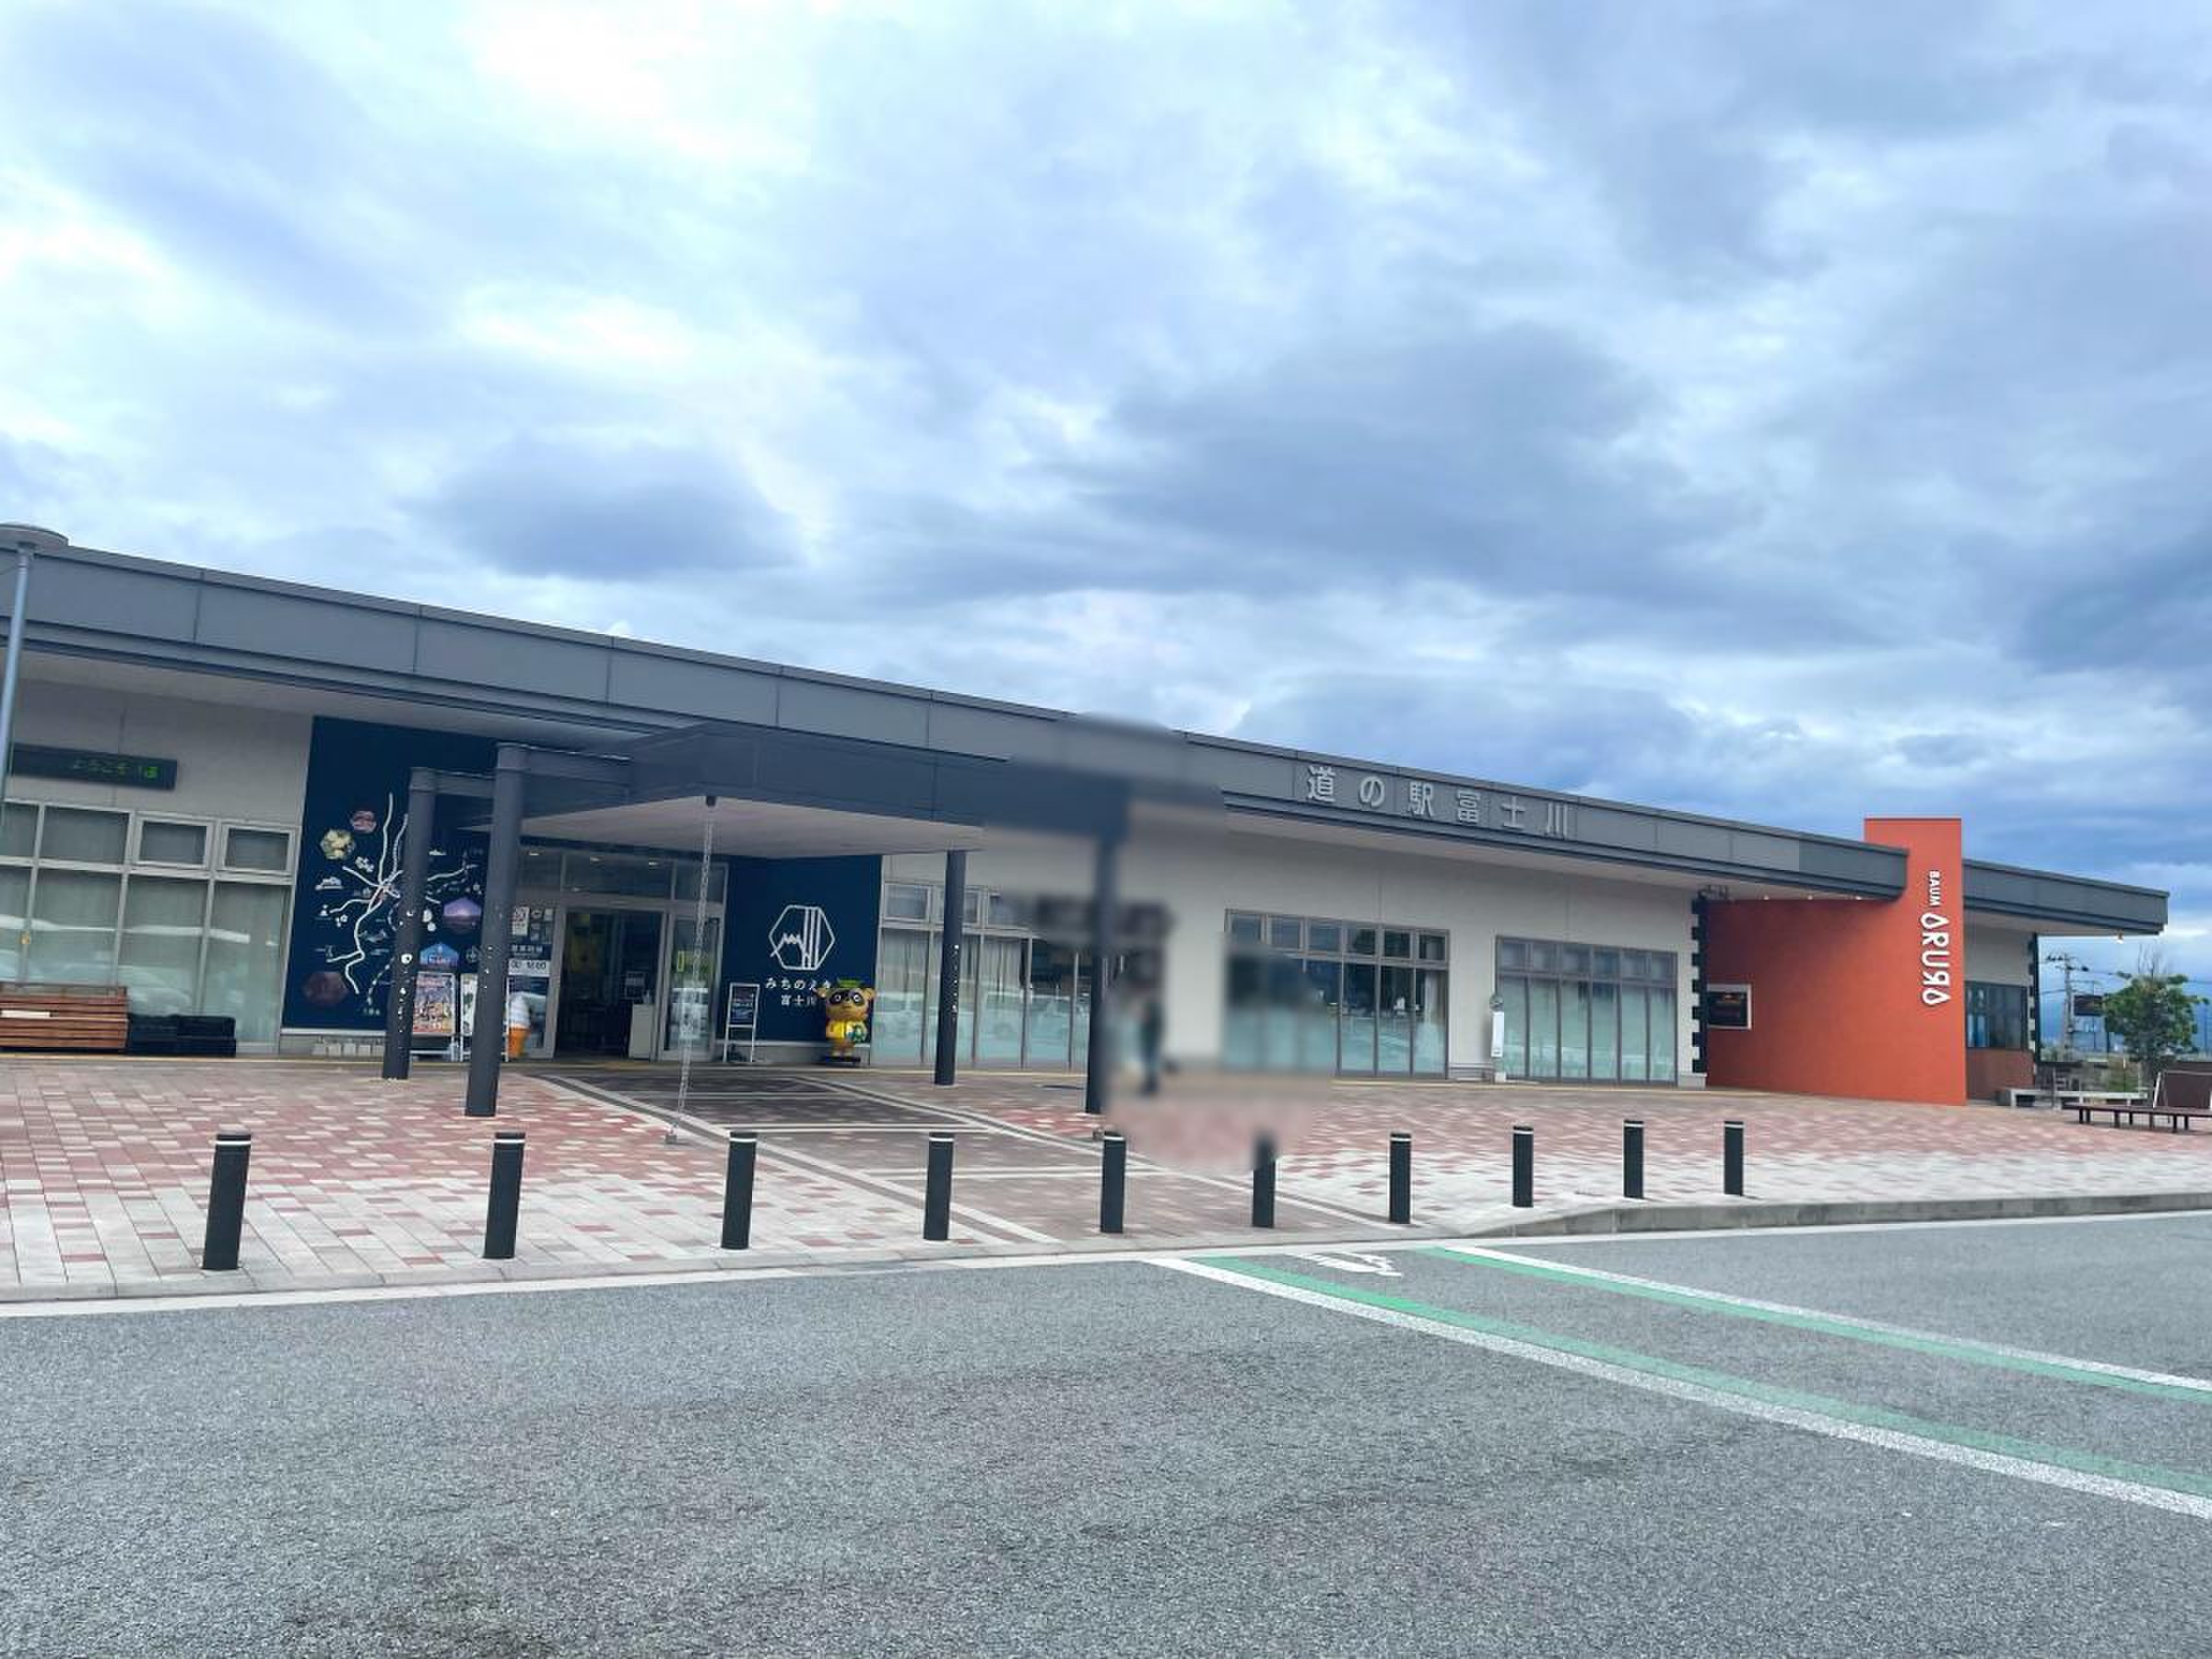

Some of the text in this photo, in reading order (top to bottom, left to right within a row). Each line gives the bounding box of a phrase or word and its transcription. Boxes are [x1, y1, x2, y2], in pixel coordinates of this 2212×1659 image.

[1307, 765, 1569, 838] 道の駅富士川
[1929, 870, 1940, 906] BAUM
[781, 994, 818, 1006] 富士川
